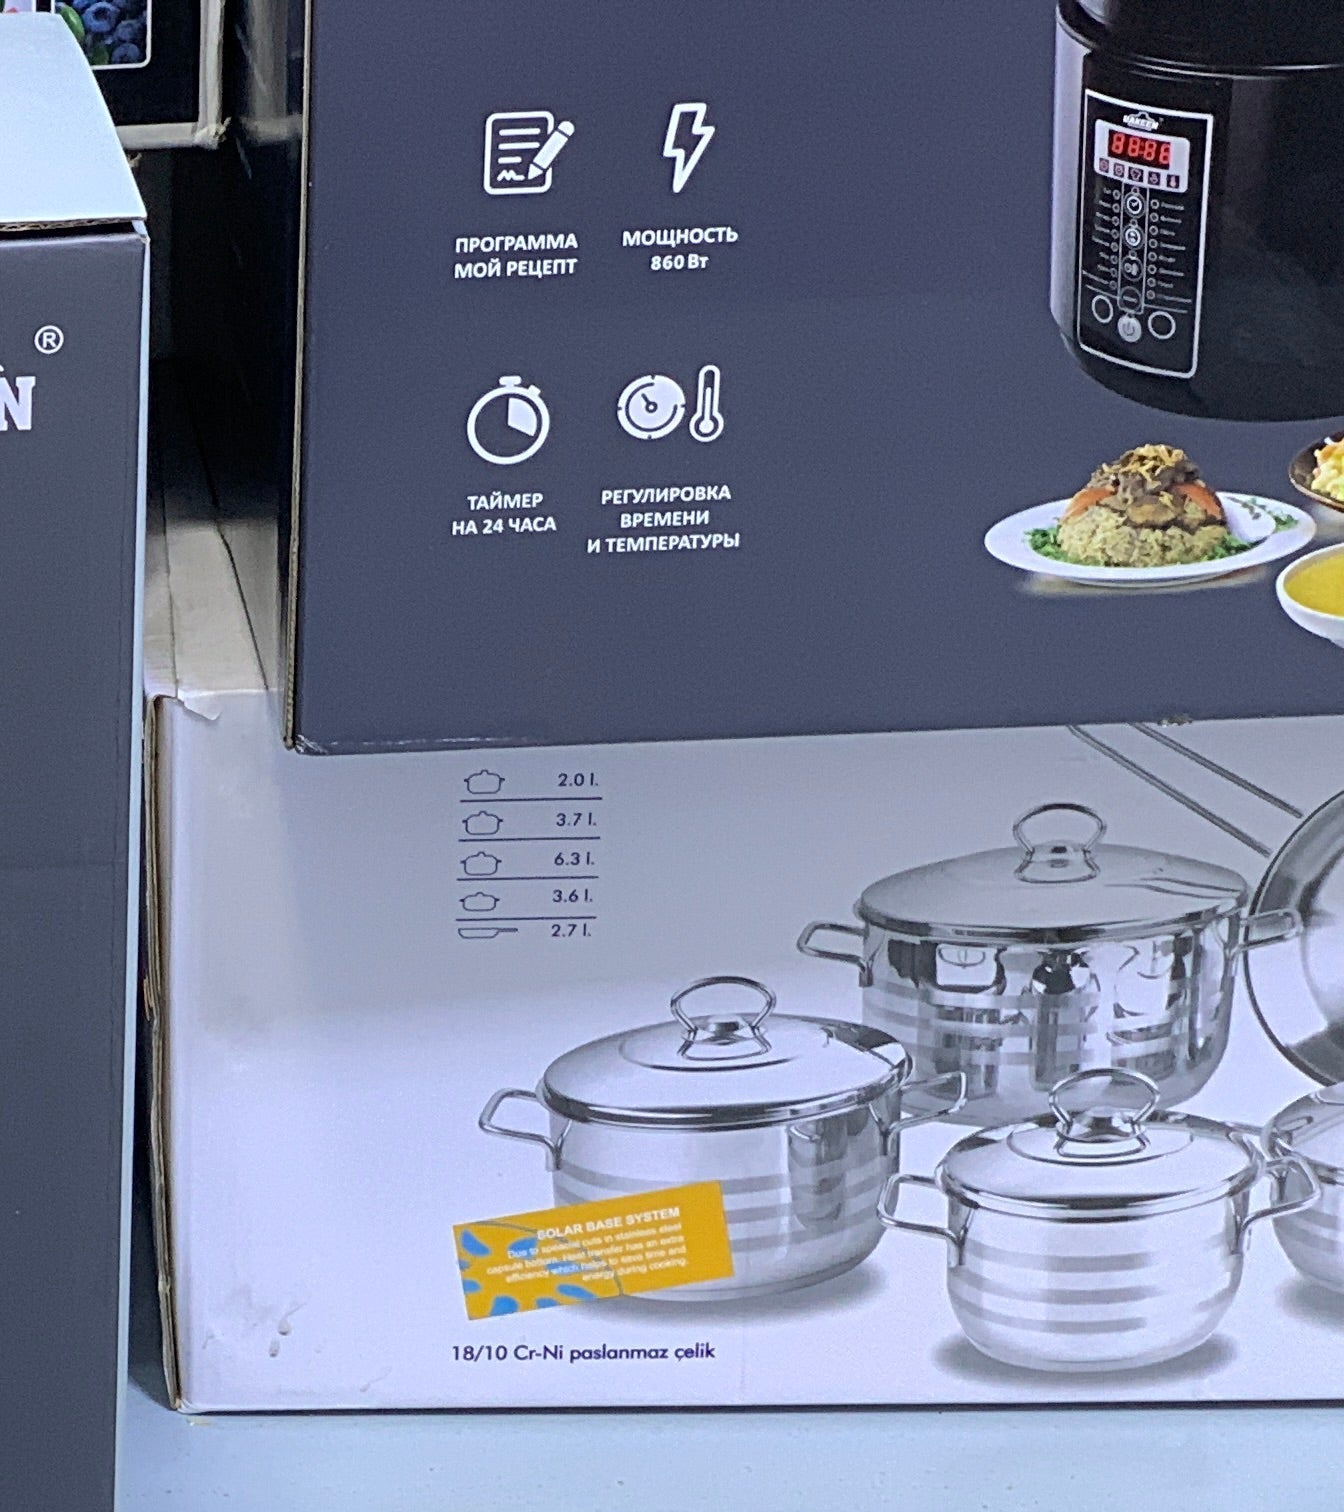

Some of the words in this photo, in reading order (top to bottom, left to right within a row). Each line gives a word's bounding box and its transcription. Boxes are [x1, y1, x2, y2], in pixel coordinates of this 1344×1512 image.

[455, 232, 579, 254] ПРОГРАММА
[622, 227, 739, 248] МОЩНОСТЬ
[454, 259, 502, 279] МОЙ
[506, 258, 578, 279] РЕЦЕПТ
[650, 255, 684, 271] 860
[687, 254, 709, 269] Вт
[467, 490, 544, 512] ТАЙМЕР
[601, 485, 732, 506] РЕГУЛИРОВКА
[451, 521, 477, 536] НА
[482, 518, 504, 535] 24
[508, 516, 557, 533] ЧАСА
[620, 510, 709, 529] ВРЕМЕНИ
[587, 539, 601, 554] И
[605, 532, 740, 553] ТЕМПЕРАТУРЫ
[558, 773, 585, 787] 2.0
[556, 812, 582, 827] 3.7
[554, 852, 580, 866] 6.3
[552, 889, 579, 903] 3.6
[551, 924, 577, 937] 2.7
[537, 1224, 583, 1240] SOLAR
[585, 1217, 623, 1232] BASE
[625, 1207, 680, 1226] SYSTEM
[452, 1345, 507, 1362] 18/10
[513, 1344, 563, 1361] Cr-Ni
[569, 1344, 668, 1364] paslanmaz
[675, 1342, 716, 1363] çelik
